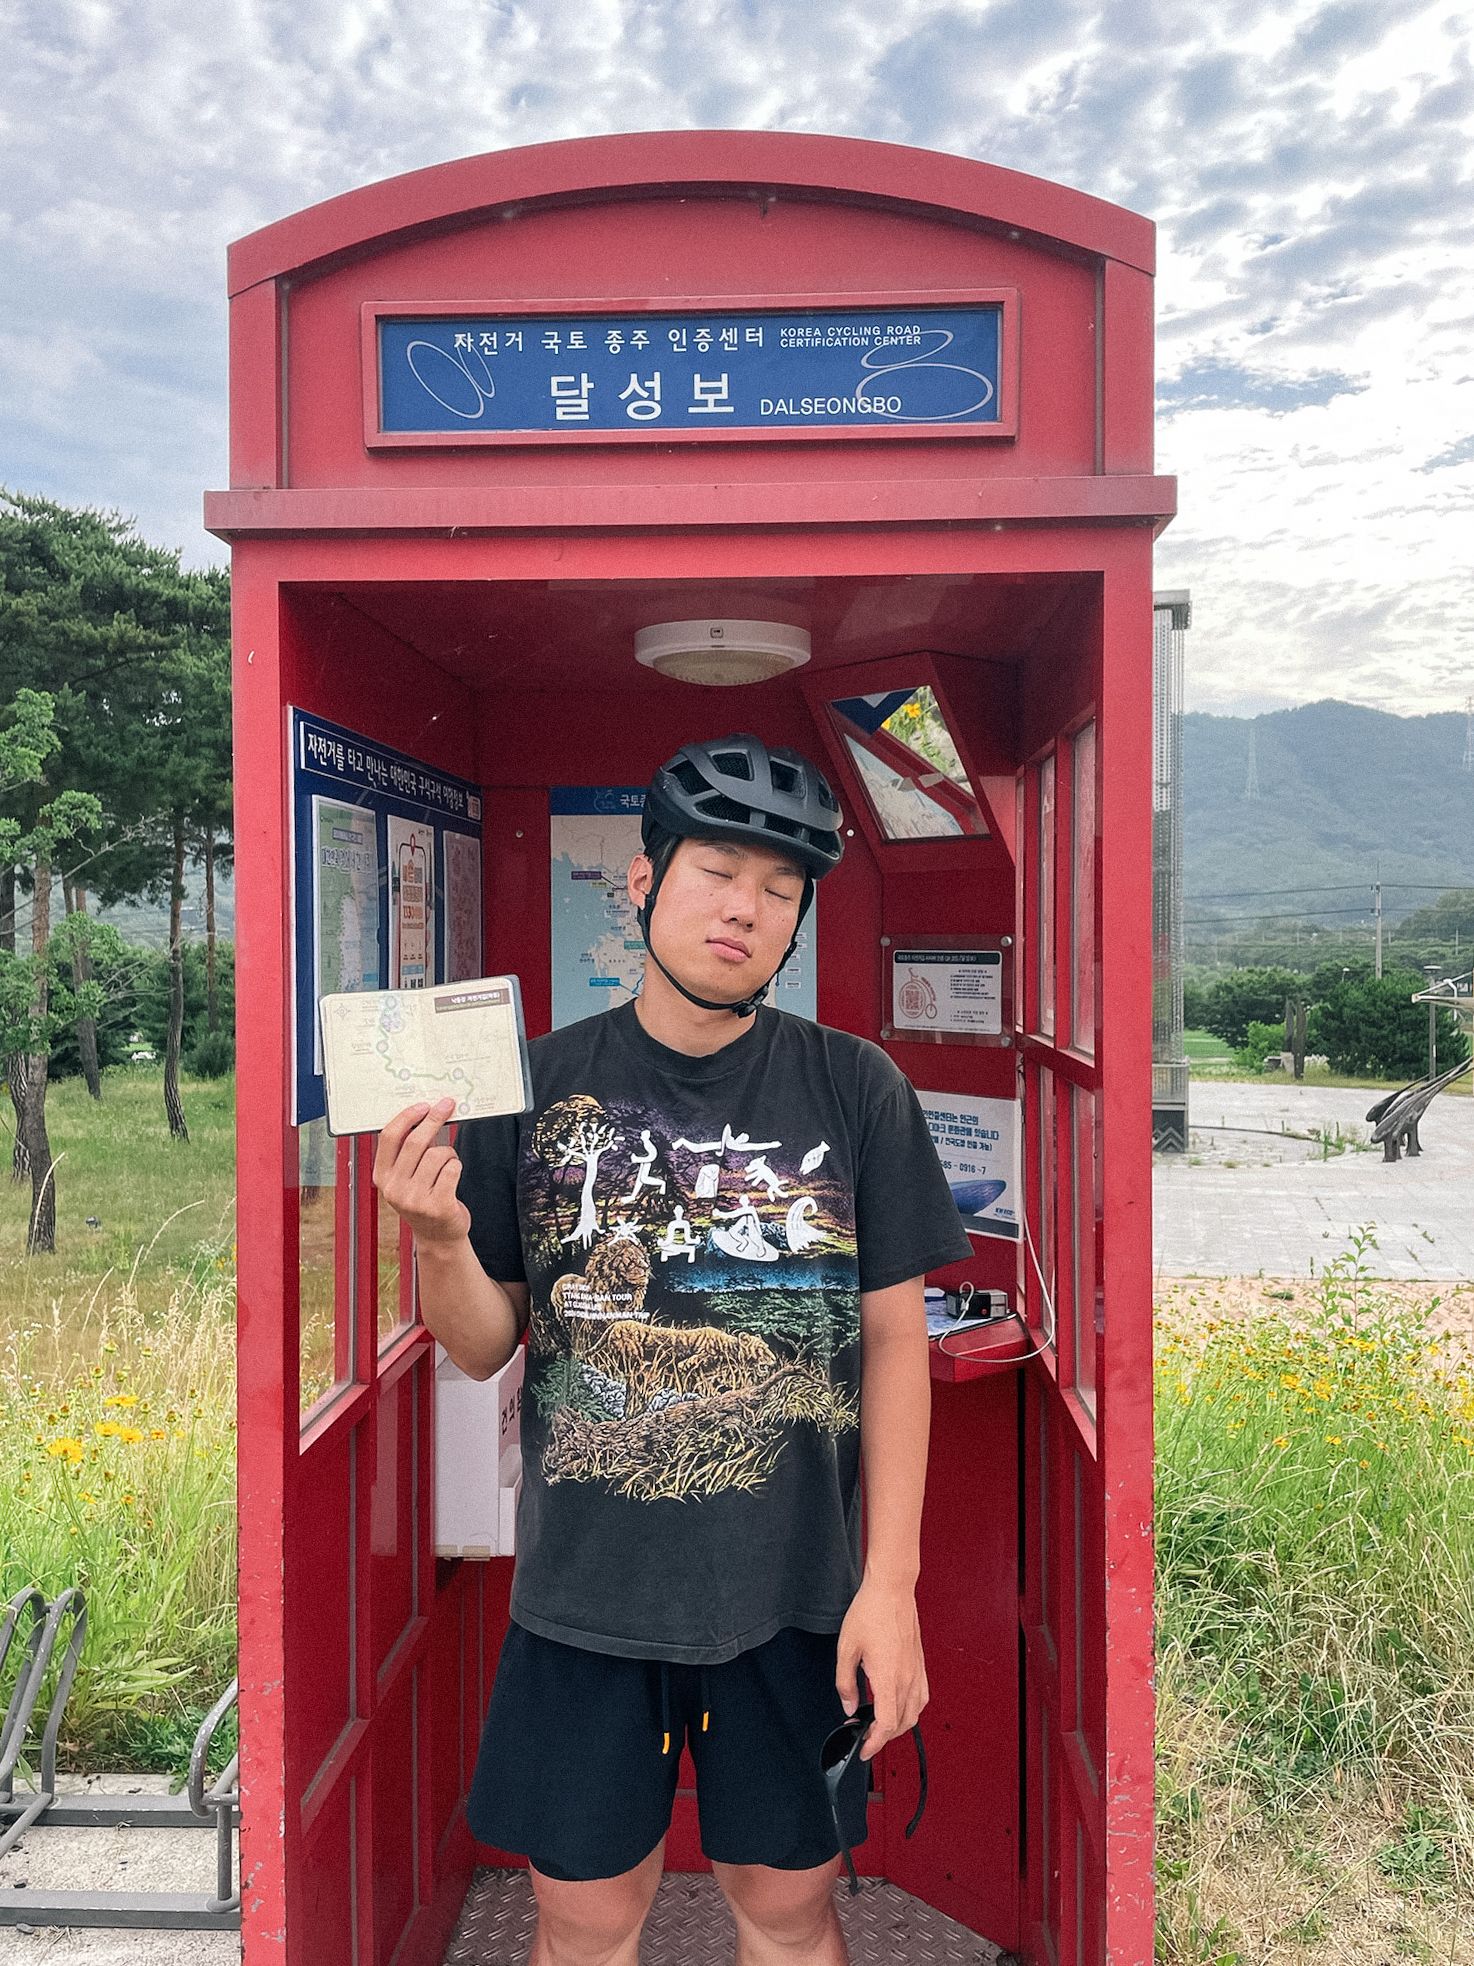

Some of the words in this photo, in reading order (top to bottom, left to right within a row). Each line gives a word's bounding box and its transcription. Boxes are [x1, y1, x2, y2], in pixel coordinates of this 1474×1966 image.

[454, 331, 524, 356] 자전거
[541, 331, 588, 355] 국토
[604, 329, 651, 355] 종주
[668, 326, 764, 353] 인증센터
[780, 328, 821, 338] KOREA
[827, 326, 881, 337] CYCLING
[886, 325, 921, 336] ROAD
[780, 337, 869, 348] CERTIFICATION
[874, 335, 922, 346] CENTER
[550, 371, 735, 421] 달성보
[760, 396, 902, 416] DALSEONGBO
[307, 733, 345, 772] 자전거를
[347, 748, 364, 772] 타고
[366, 755, 388, 787] 만나는
[390, 764, 417, 797] 대한민국
[418, 776, 442, 804] 구석구석
